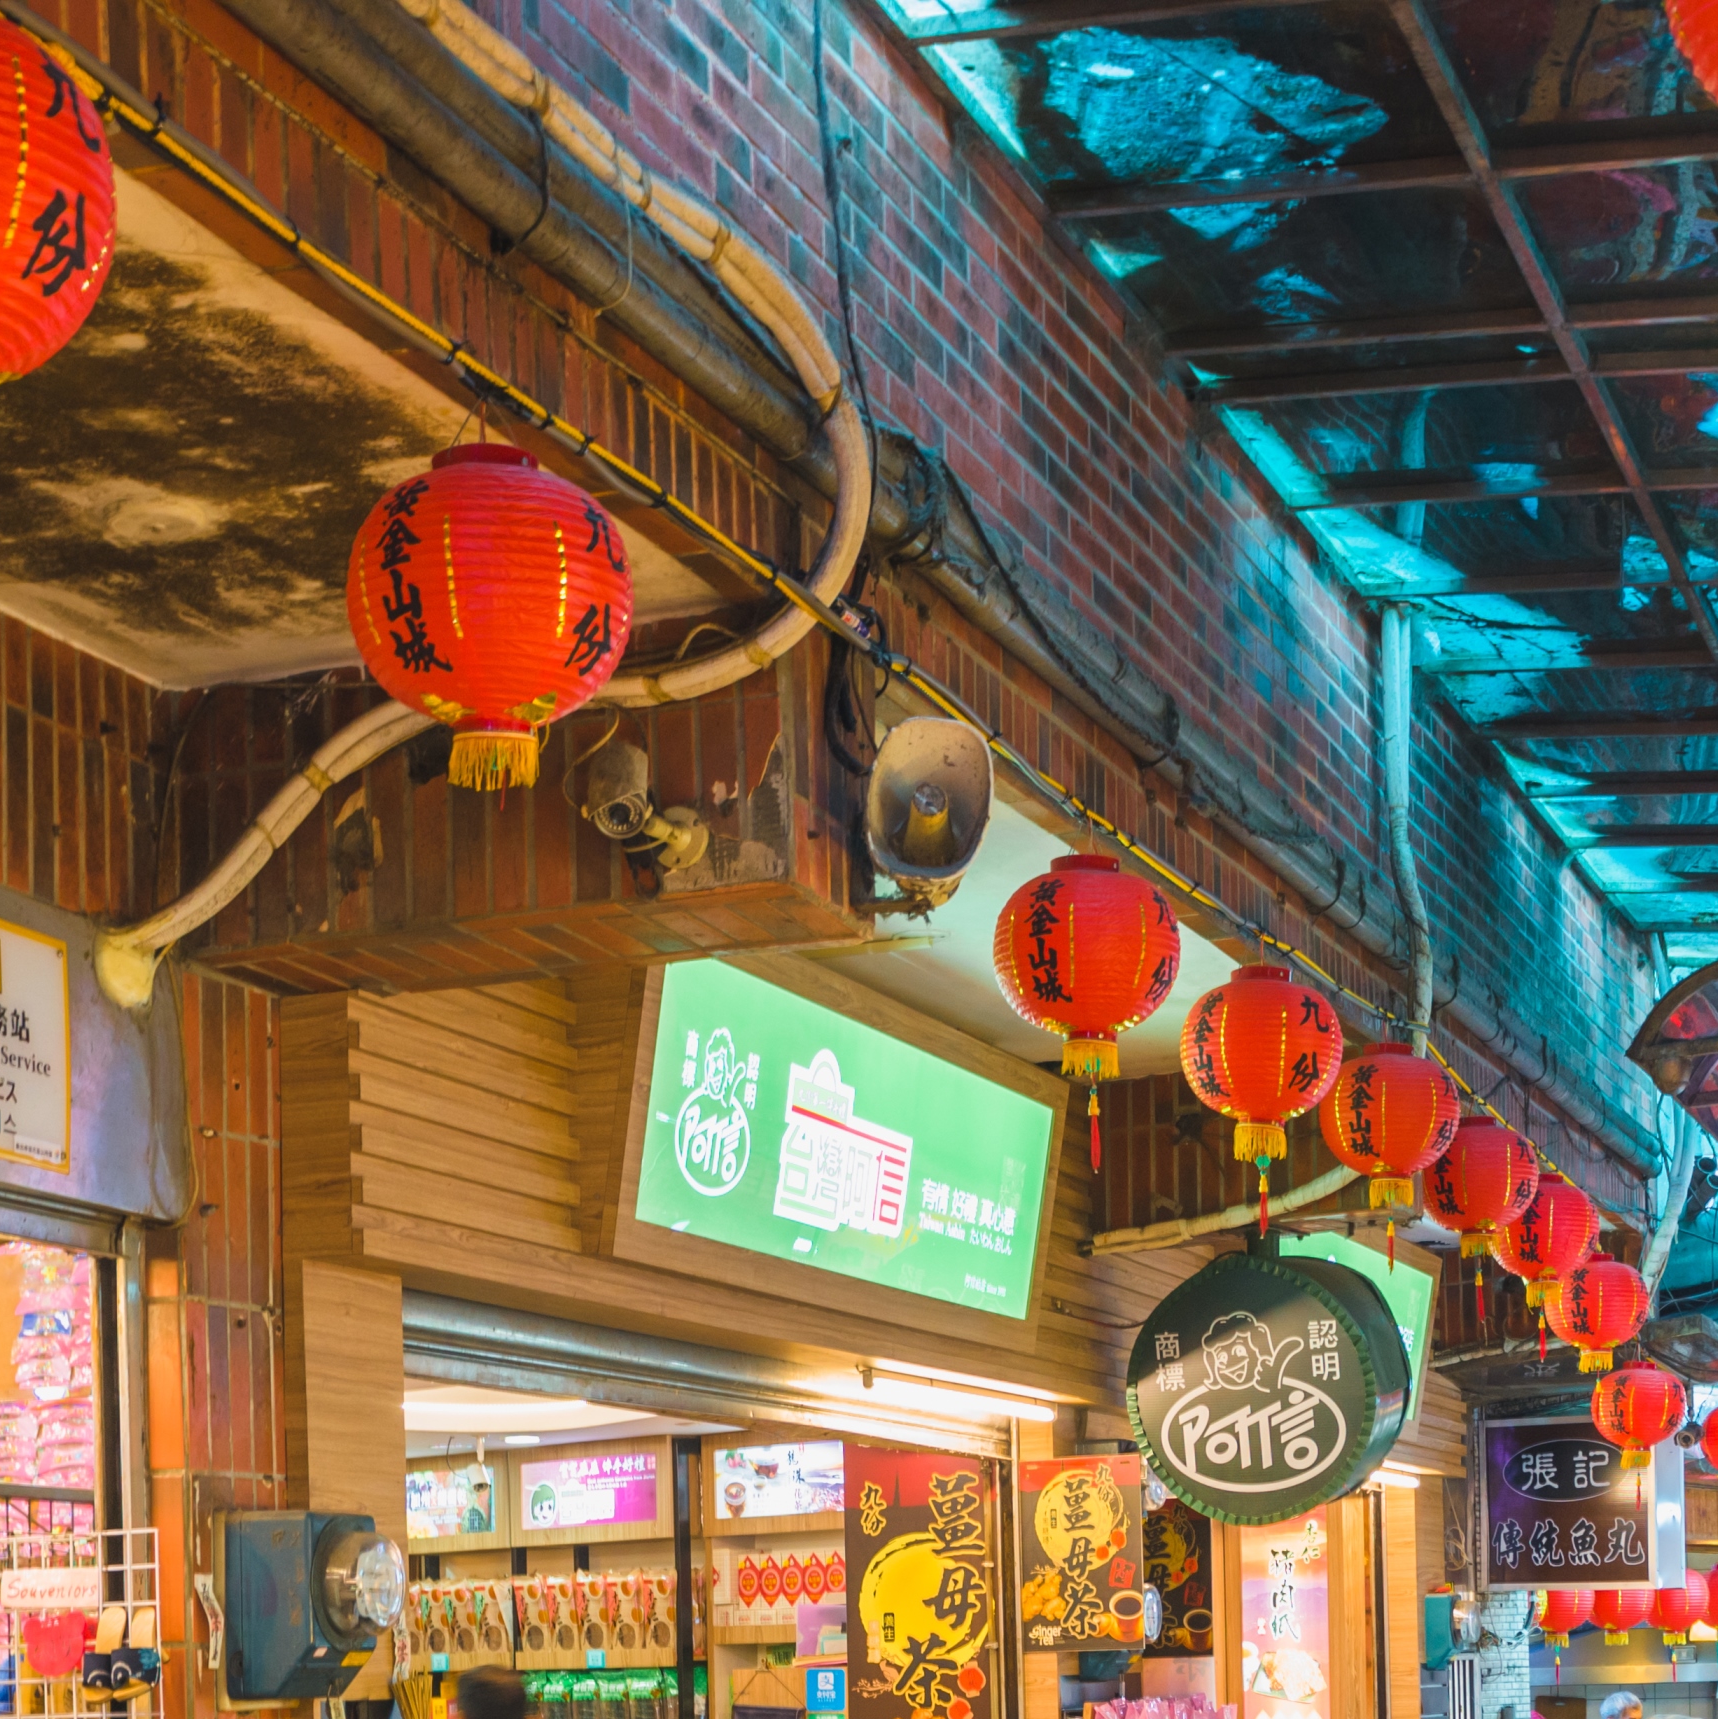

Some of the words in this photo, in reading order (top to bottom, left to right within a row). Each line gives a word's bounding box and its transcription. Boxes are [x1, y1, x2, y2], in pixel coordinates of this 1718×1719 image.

[0, 1045, 51, 1077] Service
[1433, 1143, 1465, 1216] 金山城
[1154, 1331, 1186, 1393] 商標
[1307, 1319, 1341, 1382] 認明
[1521, 1450, 1611, 1492] 張記
[860, 1482, 887, 1537] 九份
[1060, 1478, 1104, 1640] 薑母茶
[1491, 1517, 1647, 1570] 傳統魚丸
[892, 1469, 987, 1712] 薑母茶
